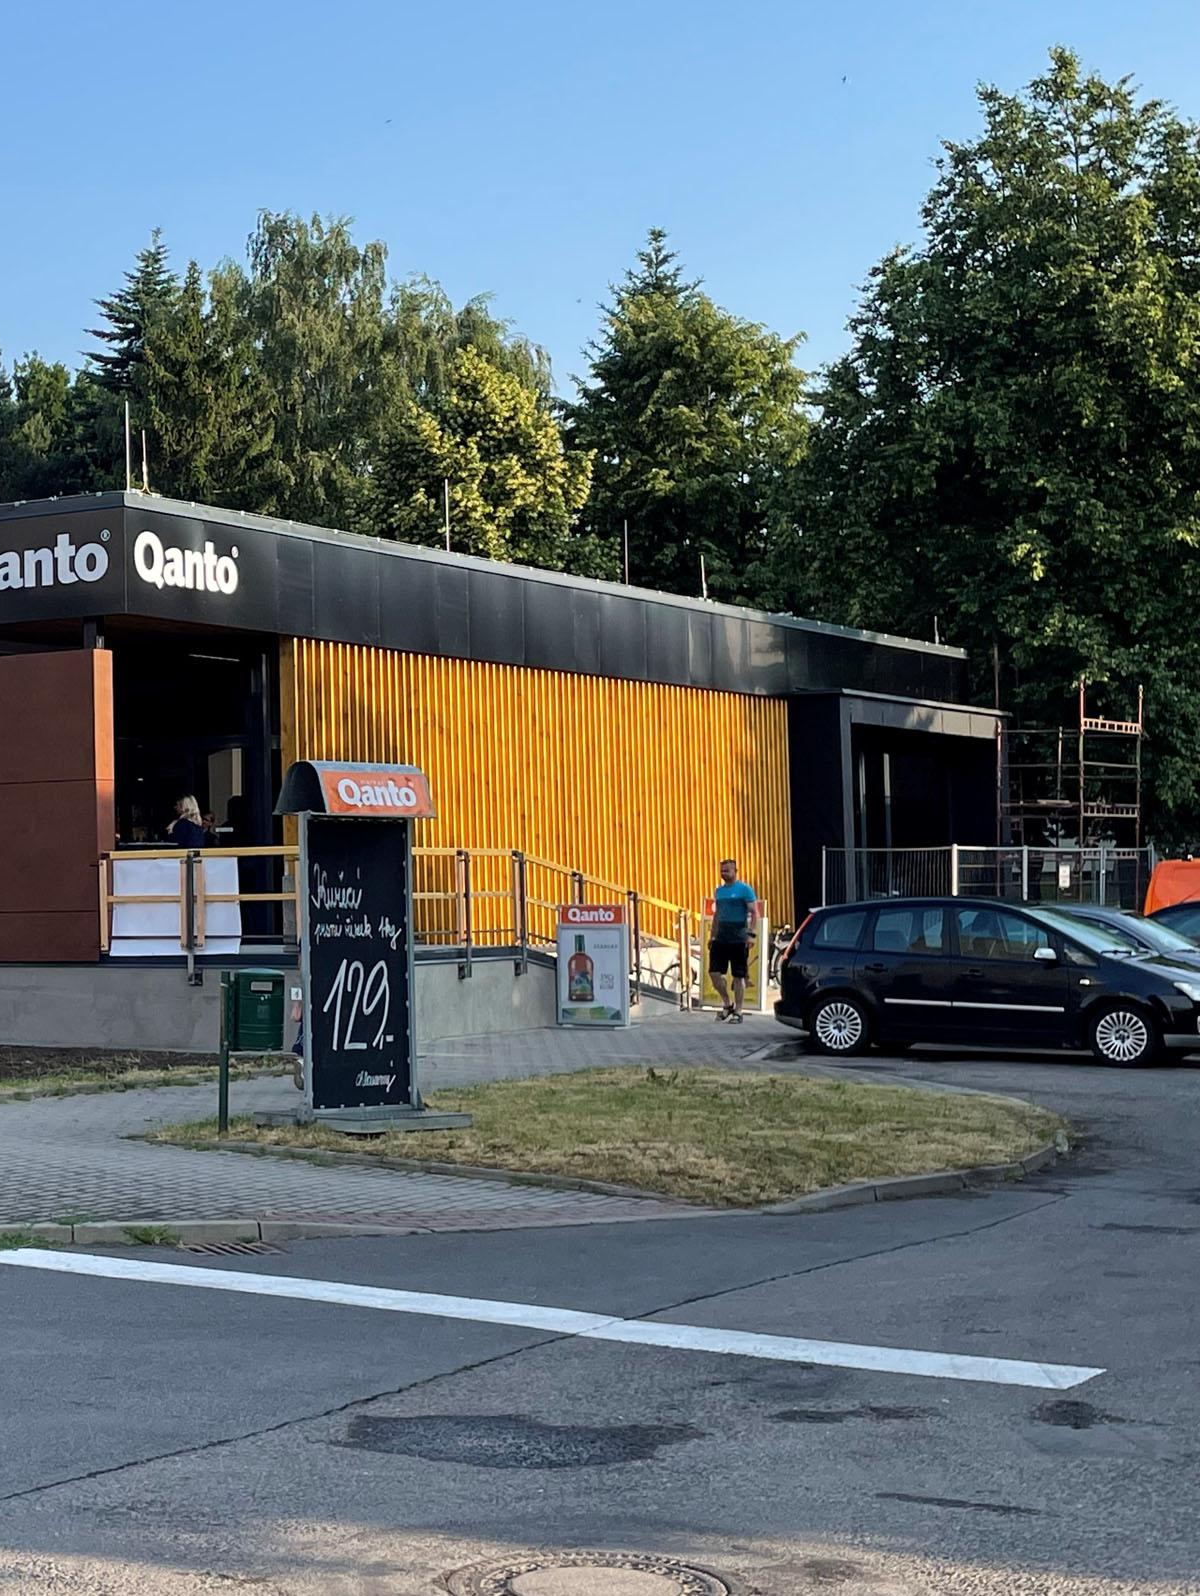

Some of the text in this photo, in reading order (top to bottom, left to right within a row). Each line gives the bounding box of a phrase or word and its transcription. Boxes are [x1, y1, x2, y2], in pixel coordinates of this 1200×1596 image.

[134, 531, 238, 595] Qanto
[338, 779, 416, 807] Qanto
[567, 908, 615, 923] Qanto
